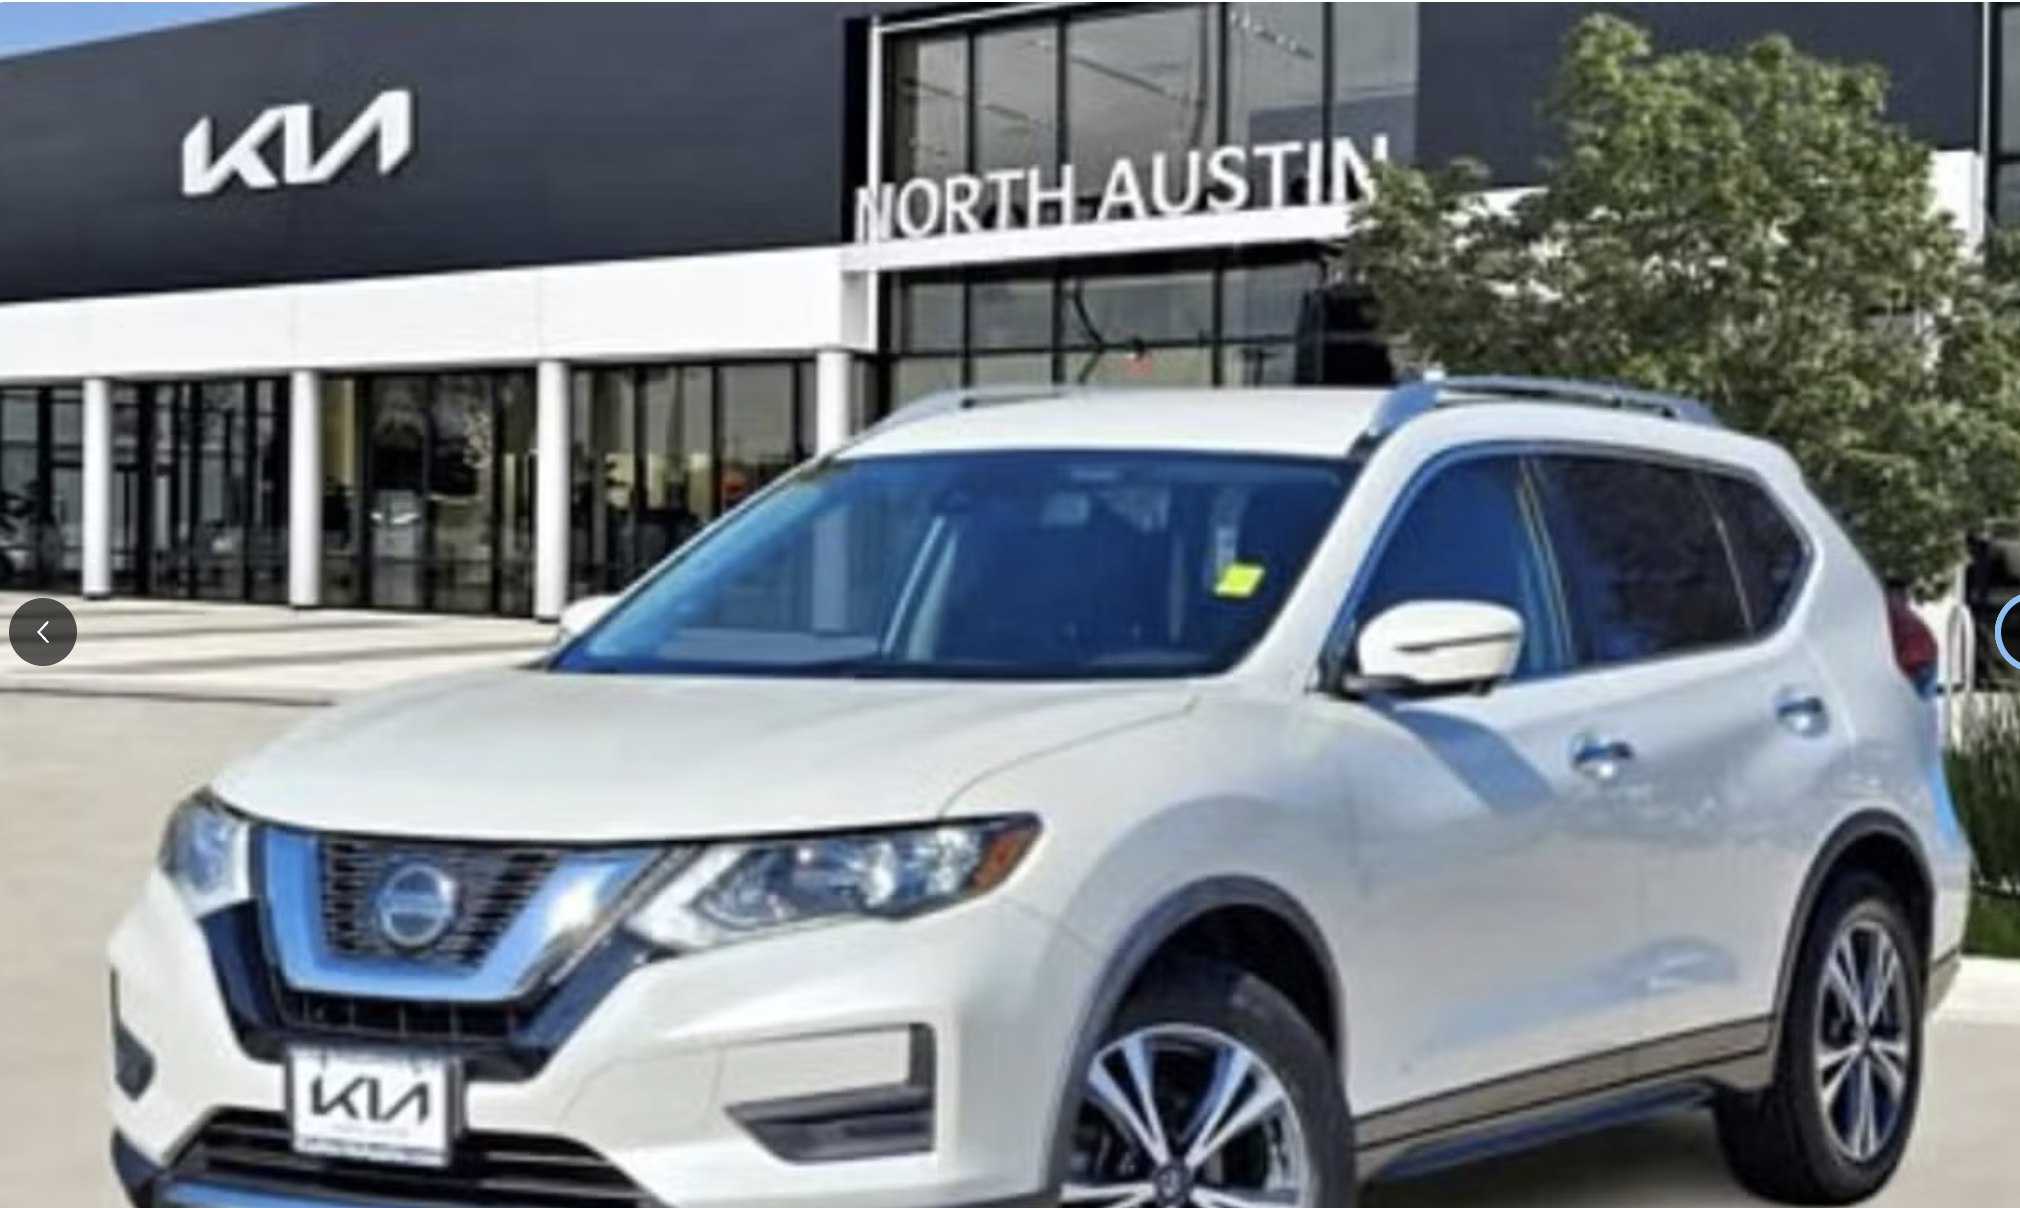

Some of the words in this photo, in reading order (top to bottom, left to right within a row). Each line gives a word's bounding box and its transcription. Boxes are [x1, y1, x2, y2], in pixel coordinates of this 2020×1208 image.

[182, 89, 412, 195] KIA
[855, 163, 1075, 244] NORTH
[1097, 134, 1388, 222] AUSTIN
[311, 1075, 428, 1125] KIA
